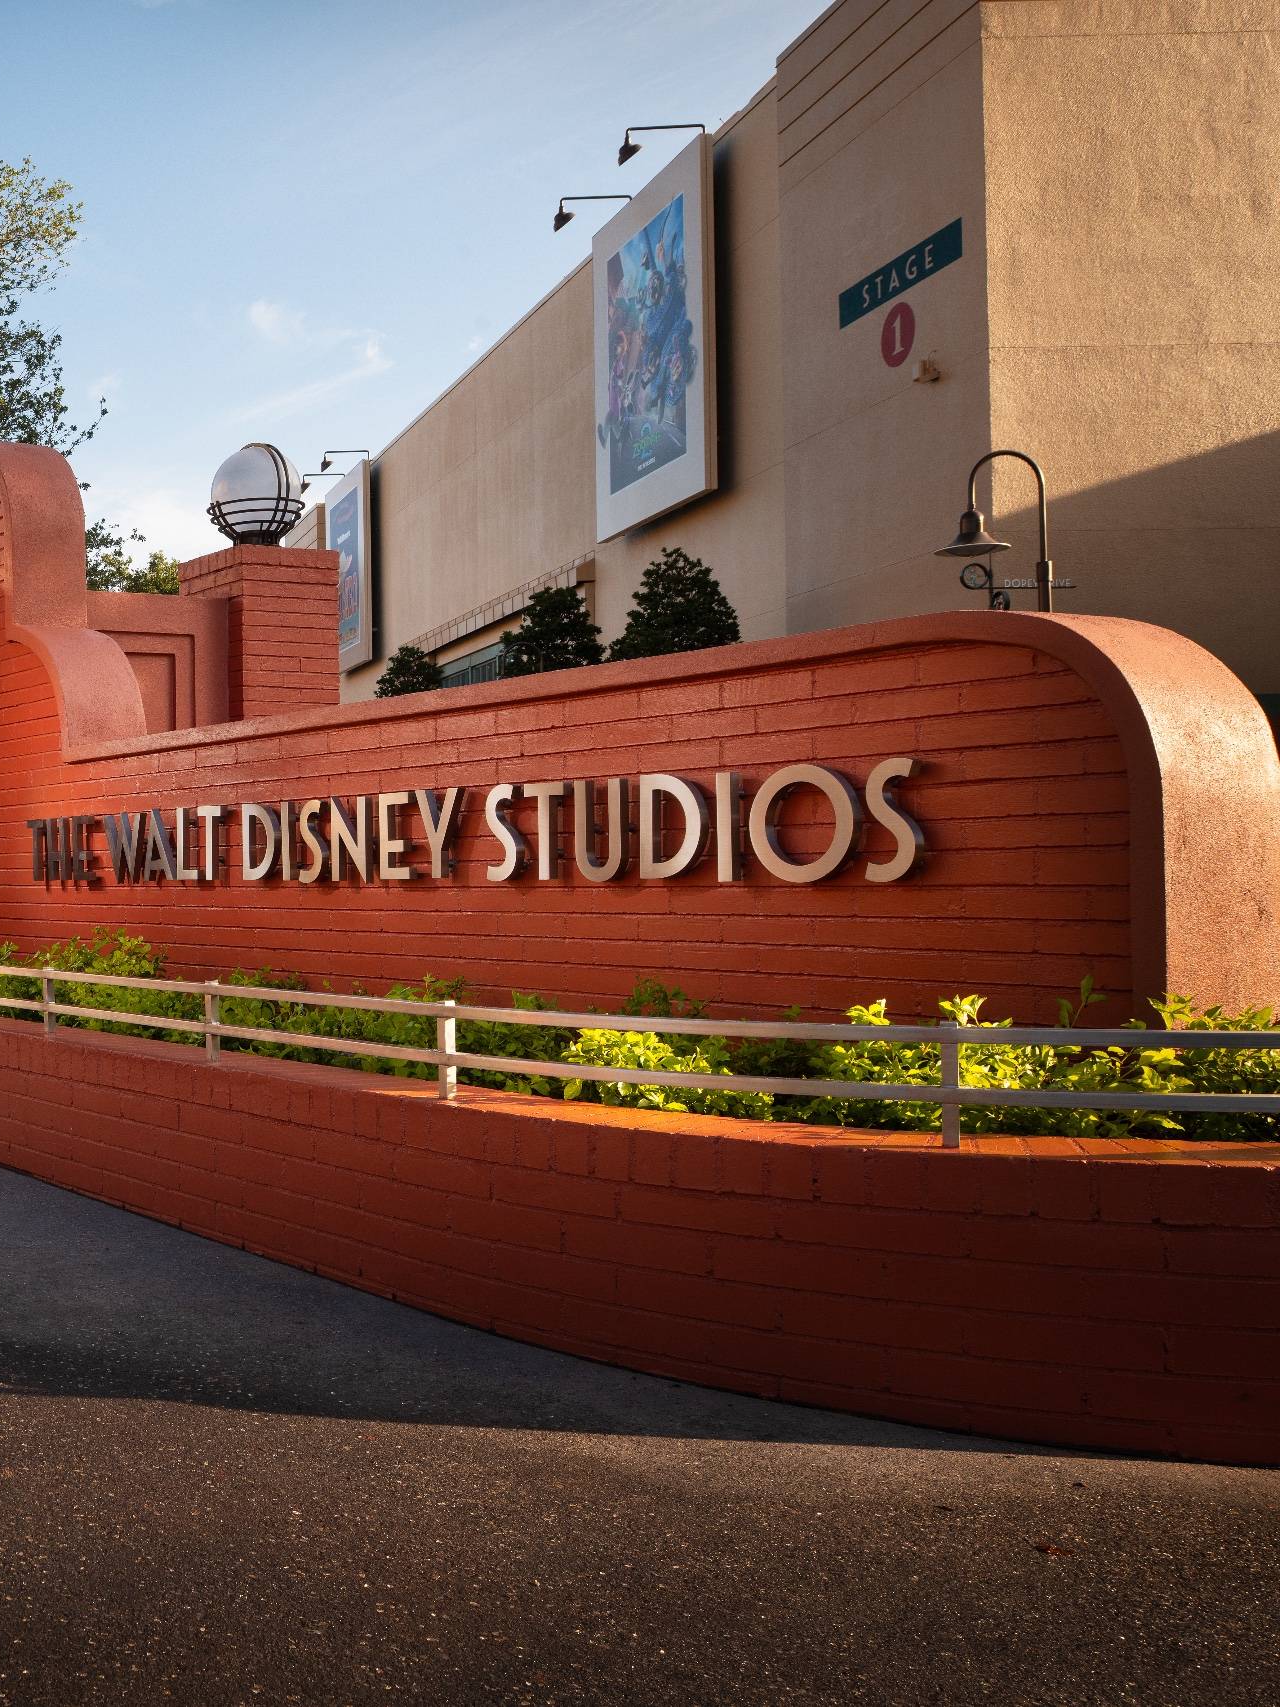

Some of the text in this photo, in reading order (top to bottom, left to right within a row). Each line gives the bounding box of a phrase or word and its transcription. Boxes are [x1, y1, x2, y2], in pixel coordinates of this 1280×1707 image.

[862, 244, 934, 308] STAGE
[891, 313, 905, 356] 1
[1049, 578, 1073, 588] RIVE
[26, 757, 924, 884] THE WALT DISNEY STUDIOS
